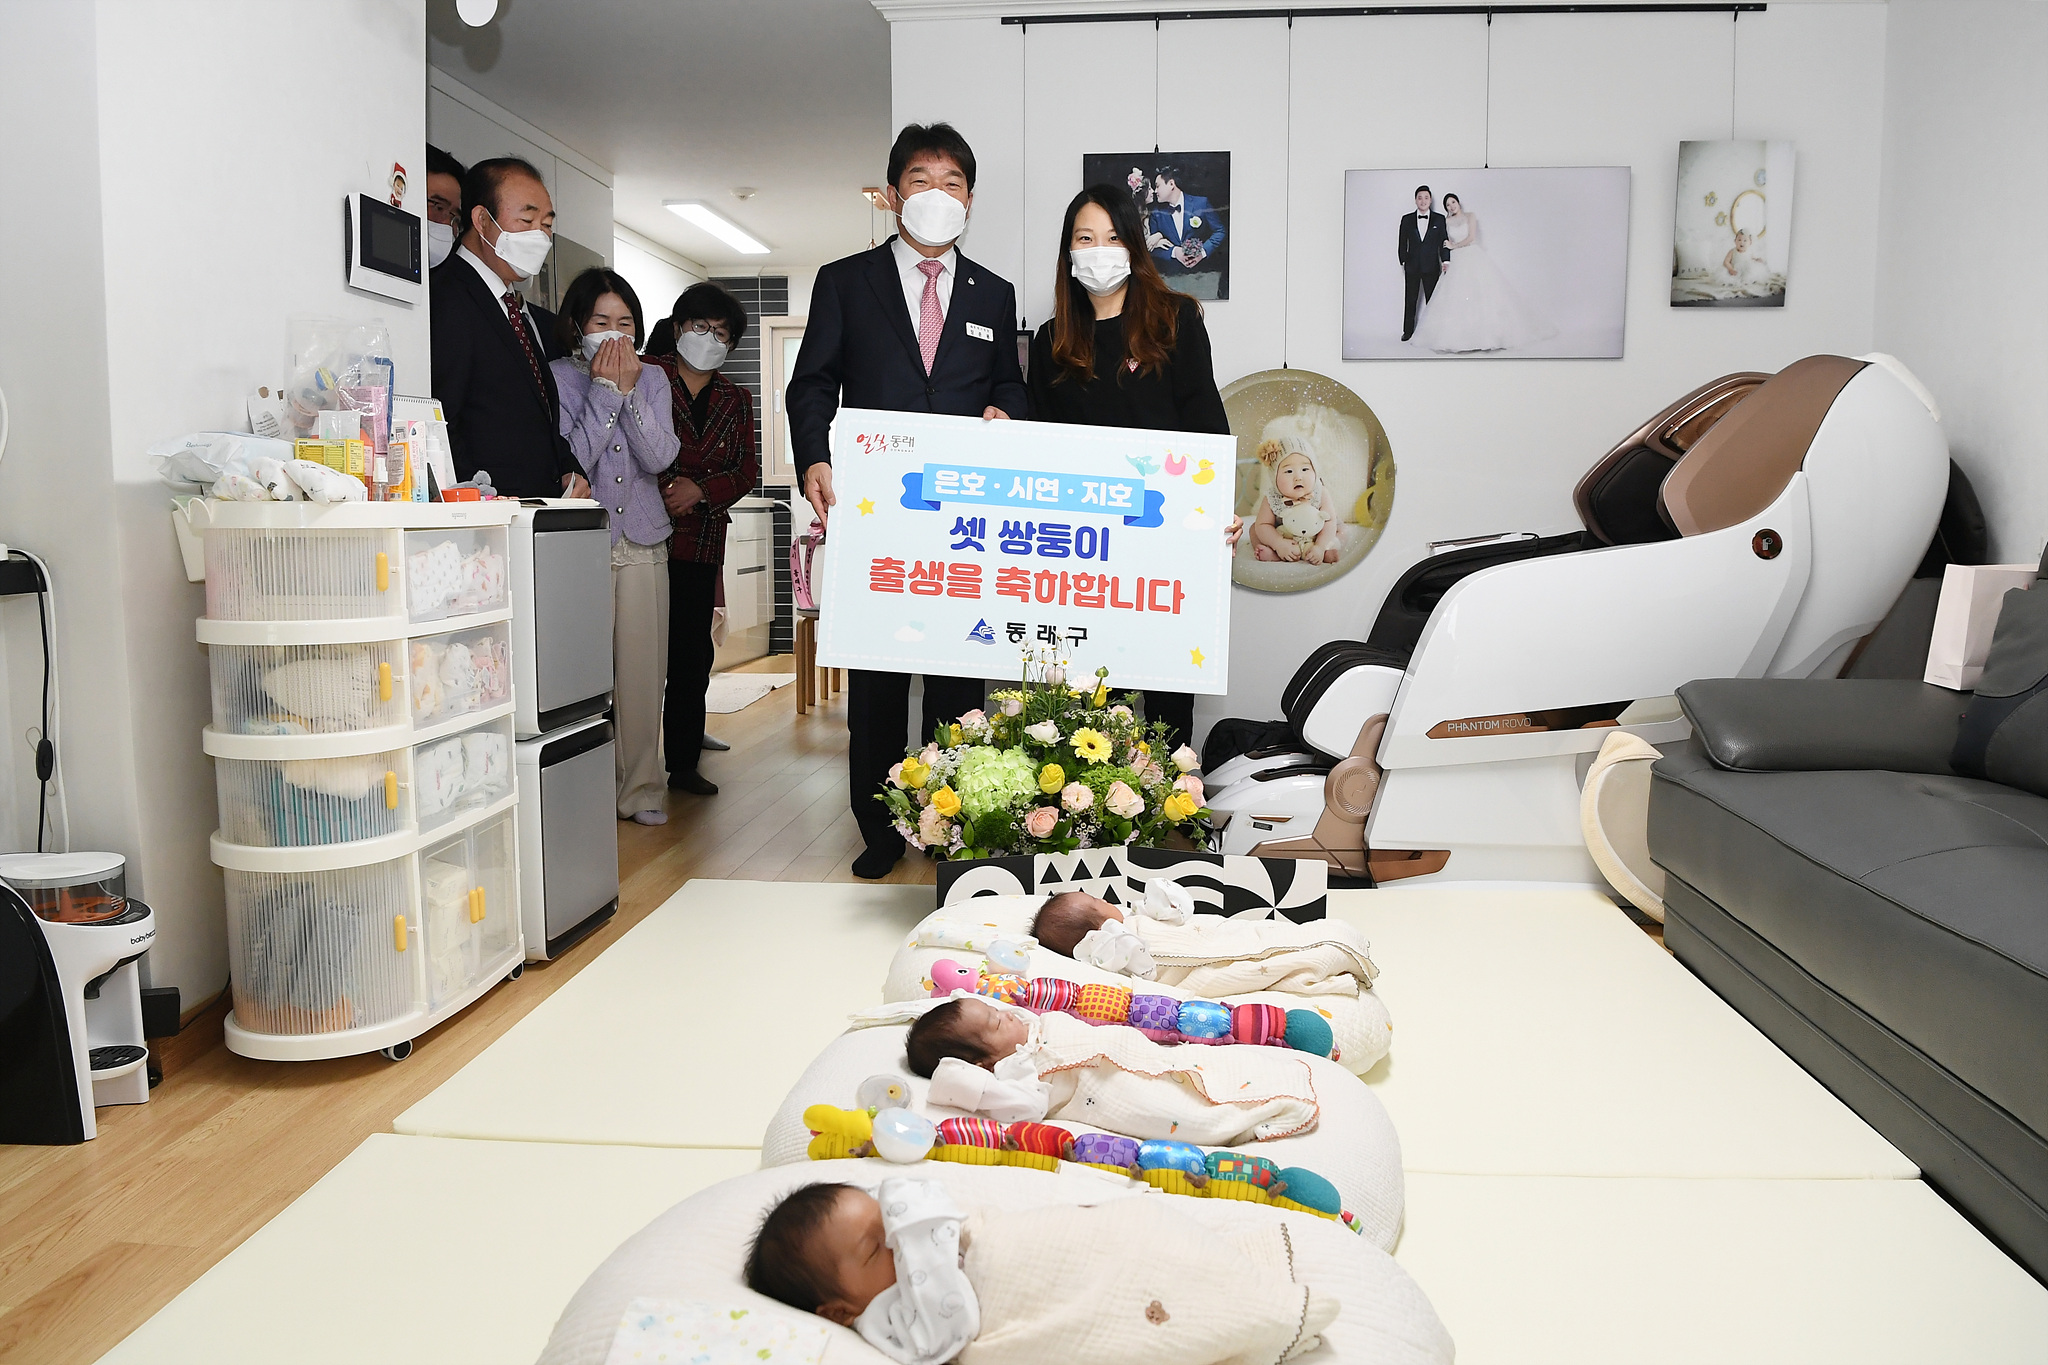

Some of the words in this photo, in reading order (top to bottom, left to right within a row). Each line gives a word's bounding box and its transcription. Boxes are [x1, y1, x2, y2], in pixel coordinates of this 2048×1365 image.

[890, 435, 915, 448] 동래
[934, 469, 986, 497] 은호
[1007, 476, 1059, 503] 시연
[1081, 481, 1133, 508] 지호
[949, 516, 986, 552] 셋
[997, 519, 1110, 562] 쌍둥이
[869, 556, 983, 600] 출생을
[995, 566, 1186, 615] 축하합니다
[1005, 621, 1088, 648] 동래구
[1447, 720, 1500, 732] PHANTOM
[1502, 717, 1532, 728] ROVO
